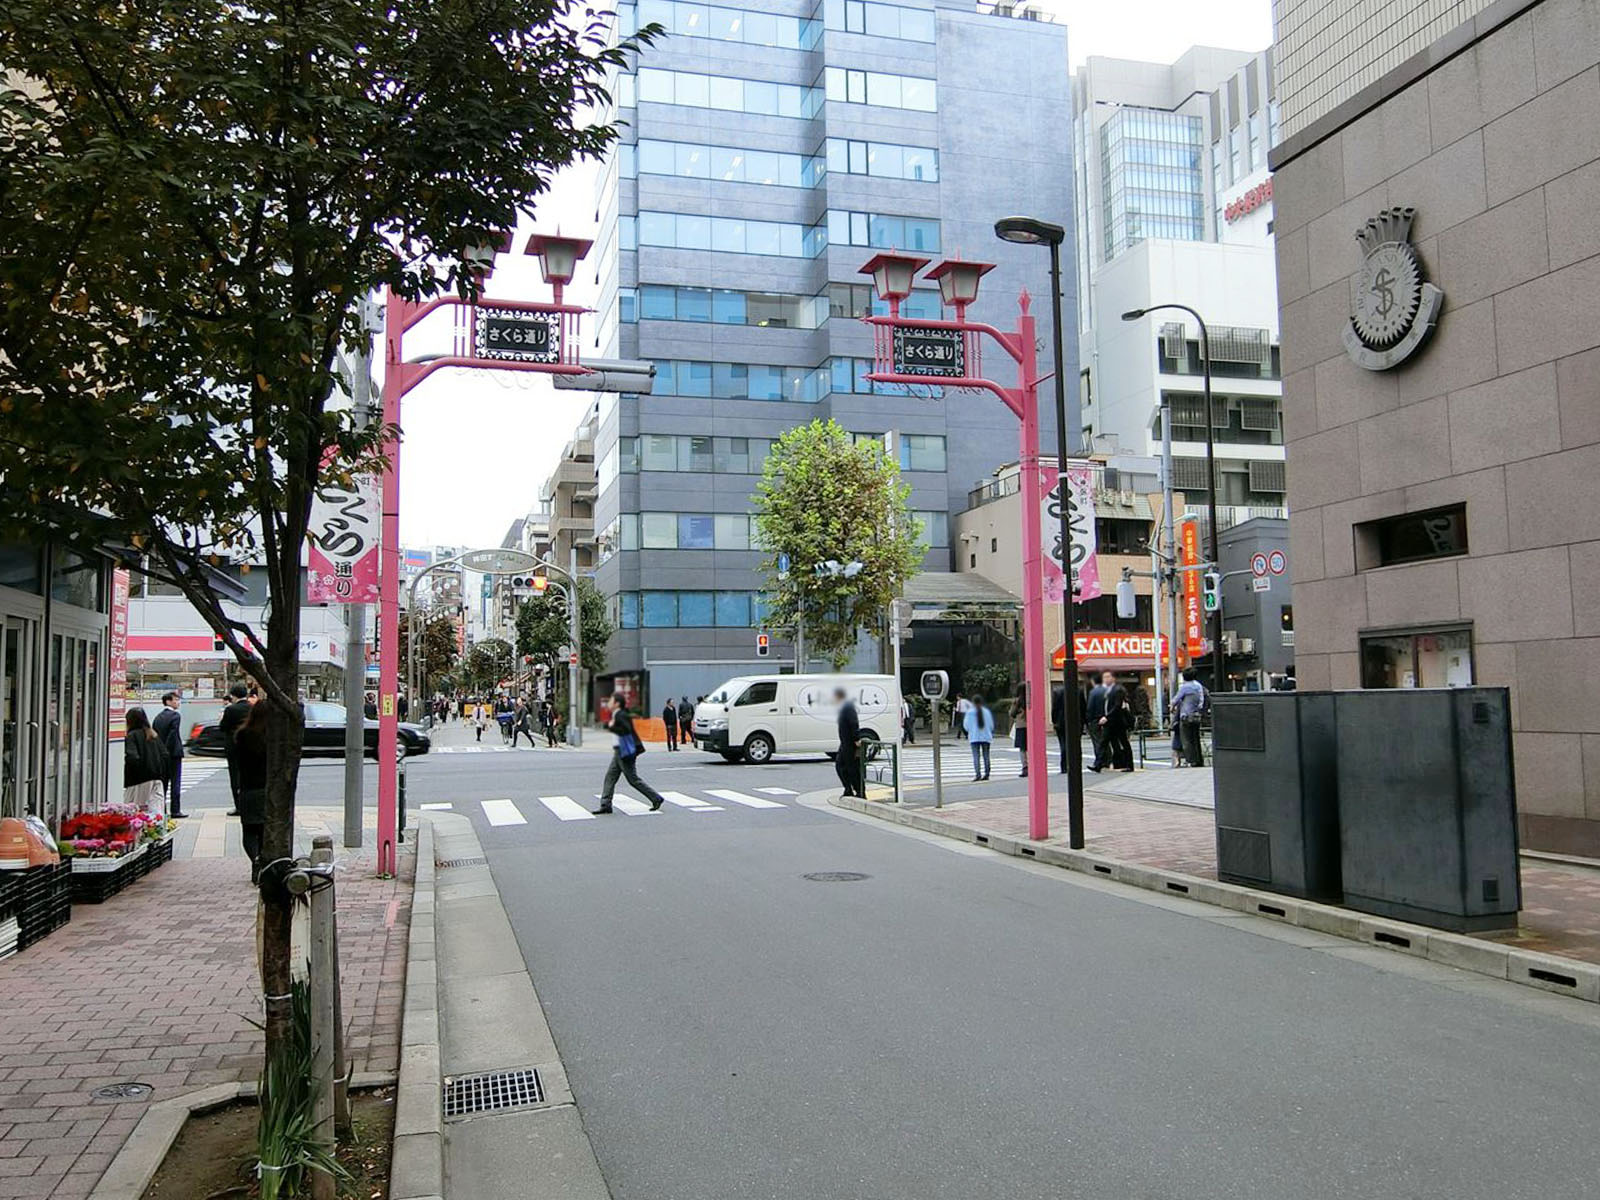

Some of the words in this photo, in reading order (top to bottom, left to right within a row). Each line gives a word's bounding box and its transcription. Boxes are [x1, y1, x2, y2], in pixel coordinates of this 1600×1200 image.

[489, 327, 546, 344] さくら通り
[905, 344, 953, 360] さくら通り
